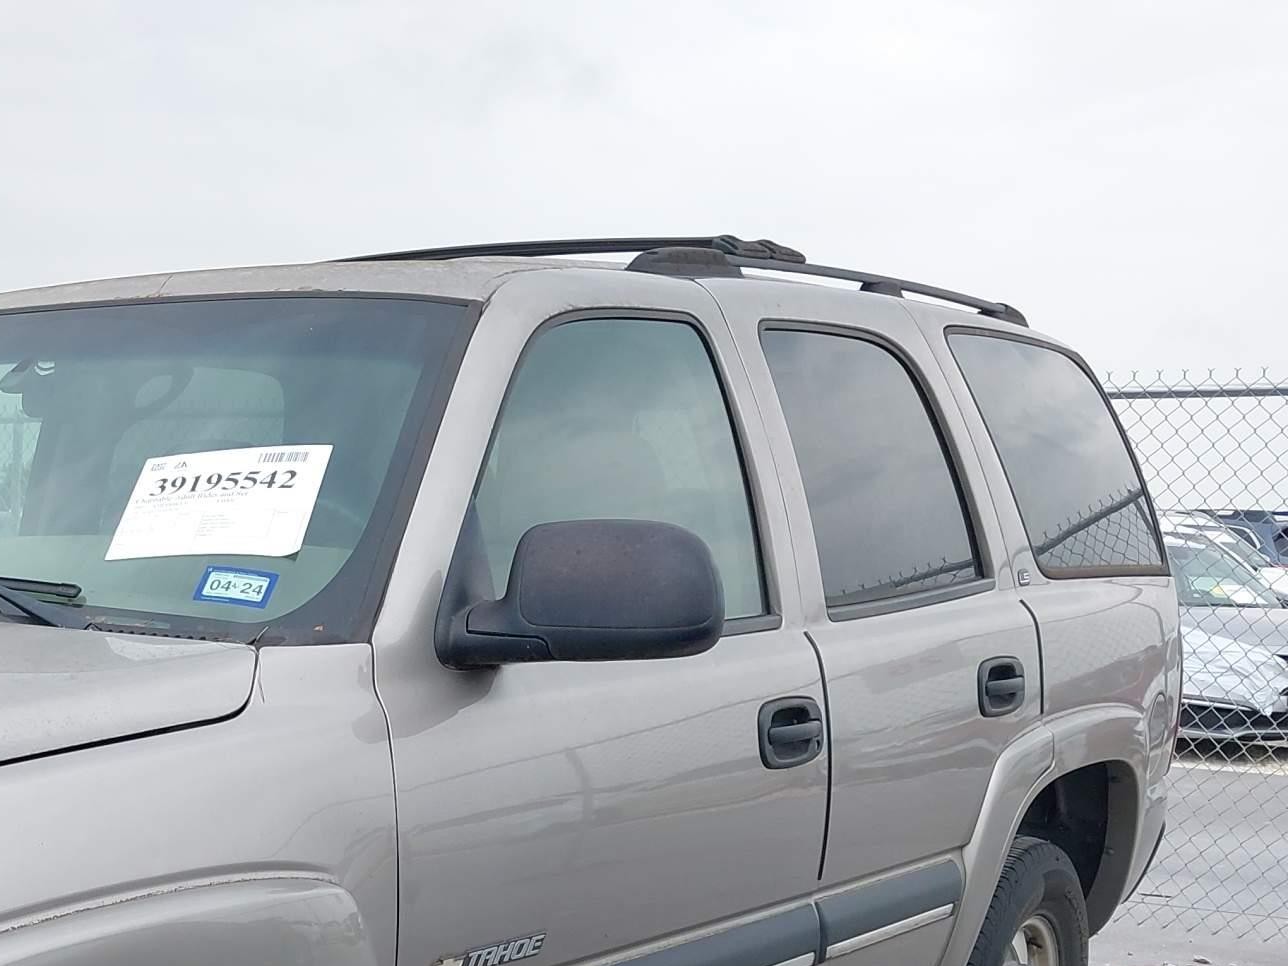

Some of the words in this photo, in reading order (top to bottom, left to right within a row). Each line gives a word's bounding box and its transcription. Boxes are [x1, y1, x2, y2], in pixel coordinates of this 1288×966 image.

[148, 469, 298, 497] 39195542
[209, 579, 232, 592] 04
[239, 582, 264, 596] 24
